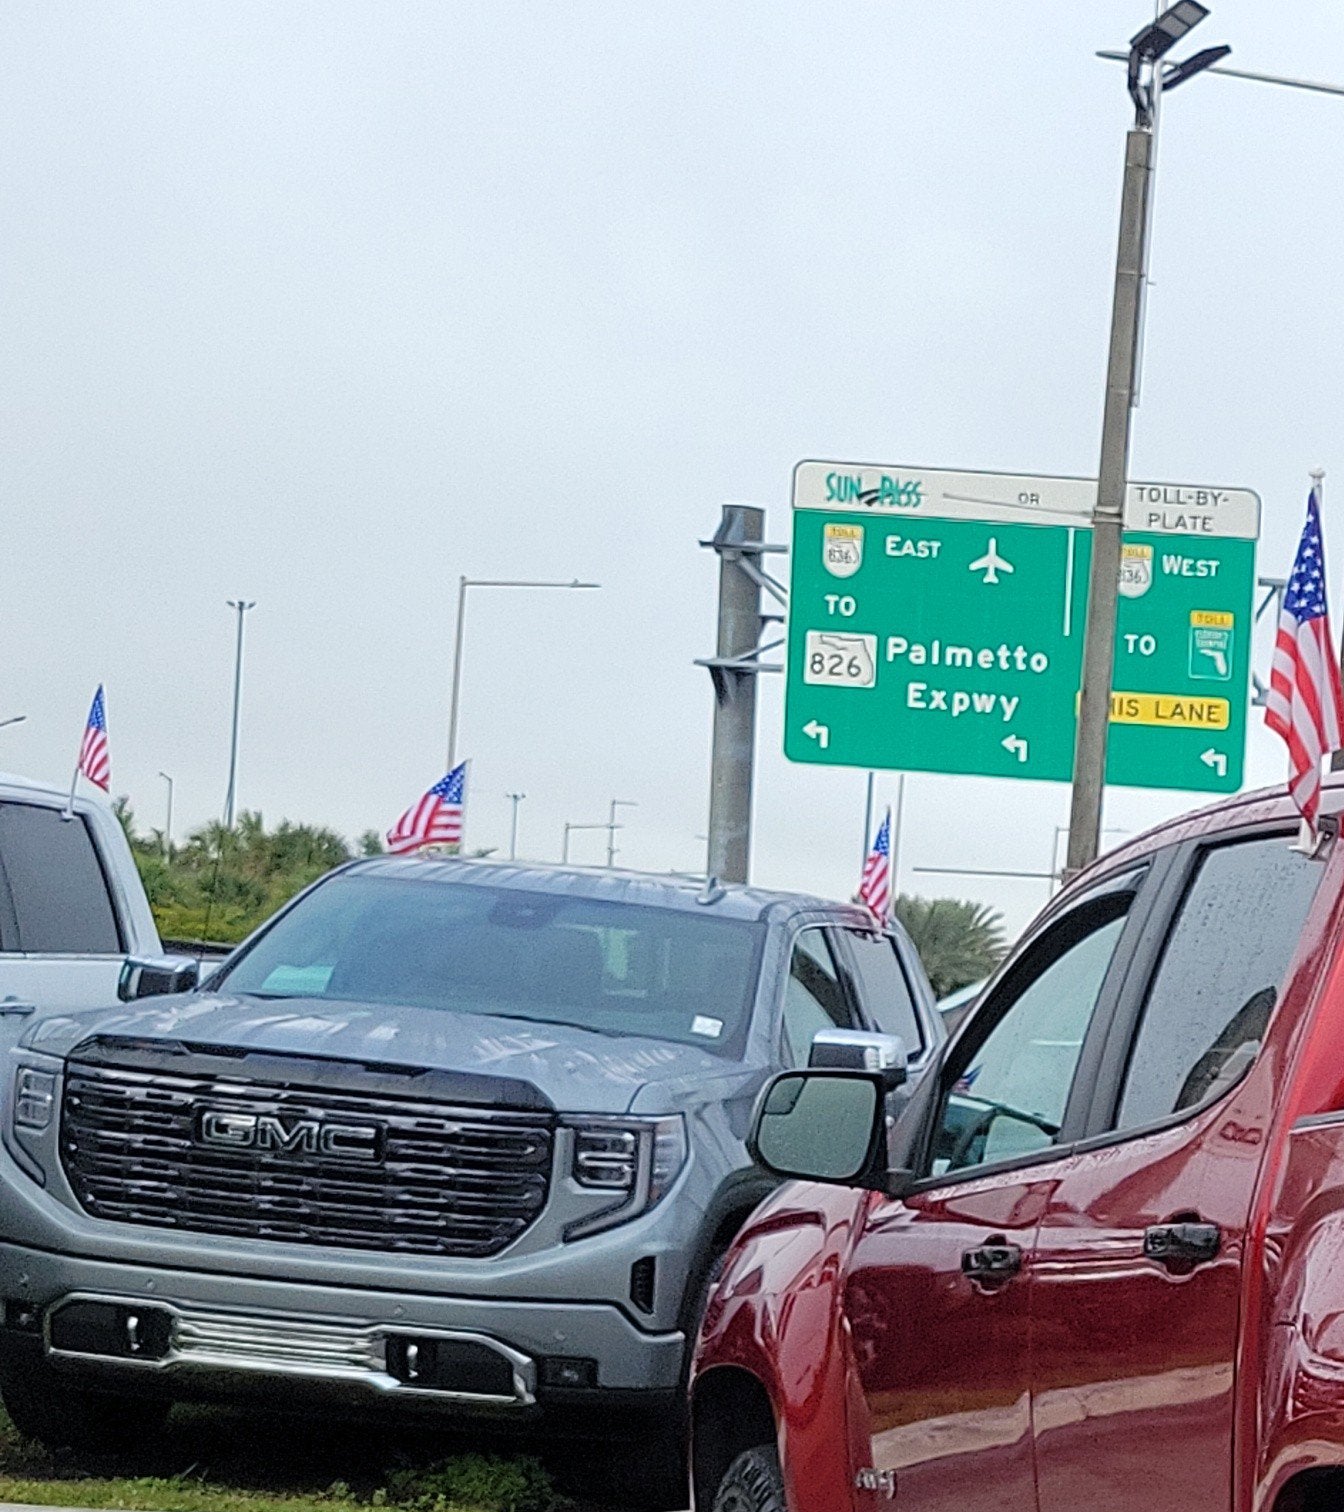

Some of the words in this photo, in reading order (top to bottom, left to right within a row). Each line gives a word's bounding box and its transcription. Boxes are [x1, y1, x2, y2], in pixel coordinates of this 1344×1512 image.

[1018, 492, 1040, 504] OR
[1149, 513, 1215, 531] PLATE
[885, 534, 942, 559] EAST
[1162, 554, 1220, 577] WEST
[824, 593, 857, 617] TO
[885, 635, 1049, 674] Palmetto
[1124, 633, 1156, 656] TO
[810, 651, 861, 678] 826
[906, 681, 1019, 722] Expwy
[1155, 700, 1221, 724] LANE
[202, 1111, 376, 1160] GMC
